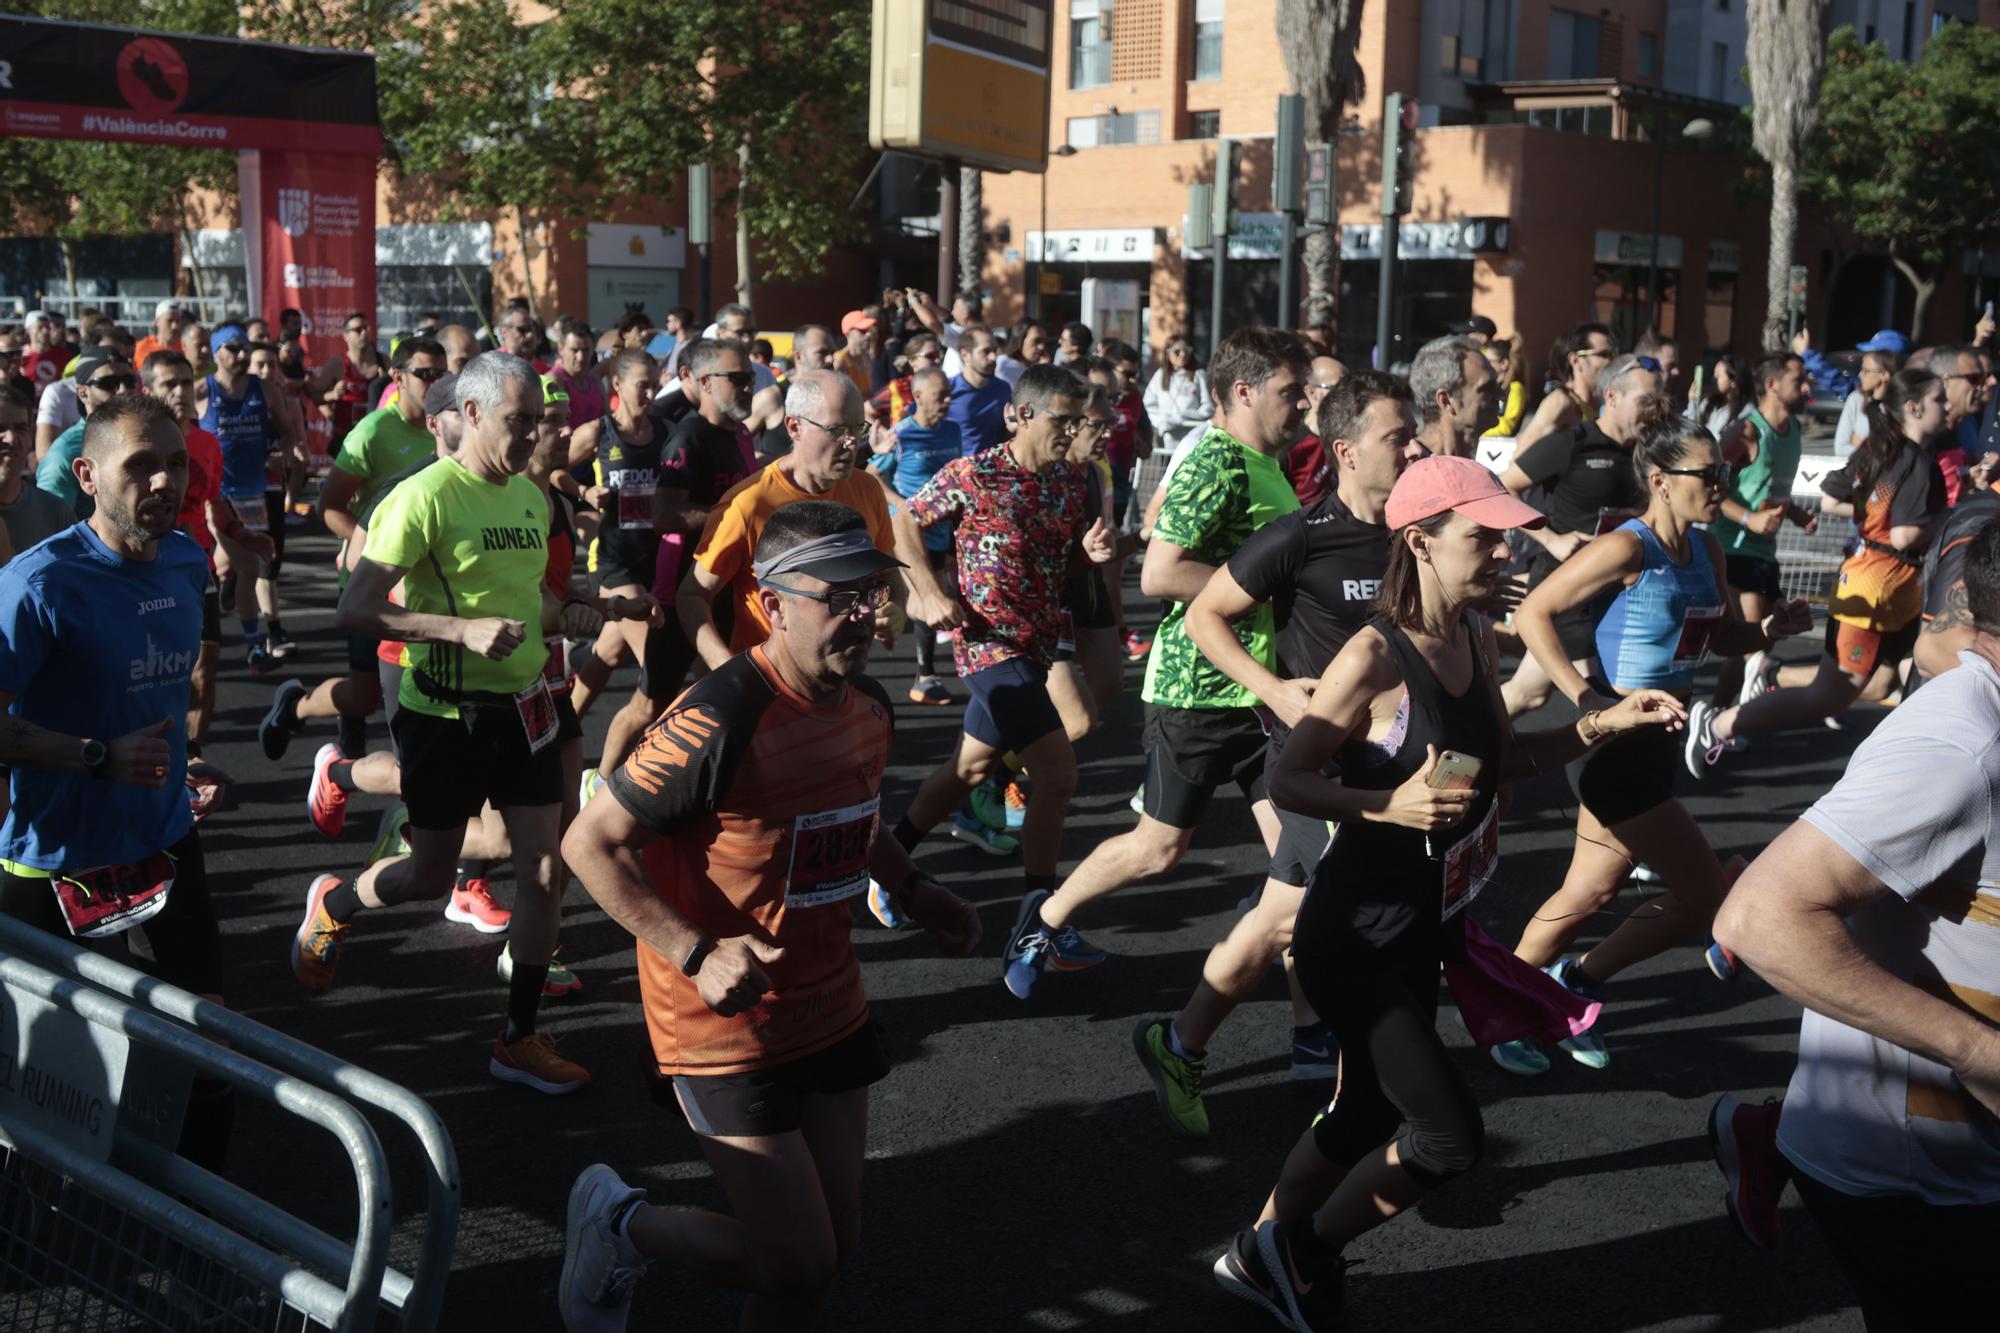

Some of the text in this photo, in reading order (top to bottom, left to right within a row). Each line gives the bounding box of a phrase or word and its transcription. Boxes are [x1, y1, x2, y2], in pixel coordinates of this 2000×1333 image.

[82, 115, 227, 139] #ValènciaCorre
[480, 527, 543, 551] RUNEAT
[20, 1064, 103, 1137] RUNNING
